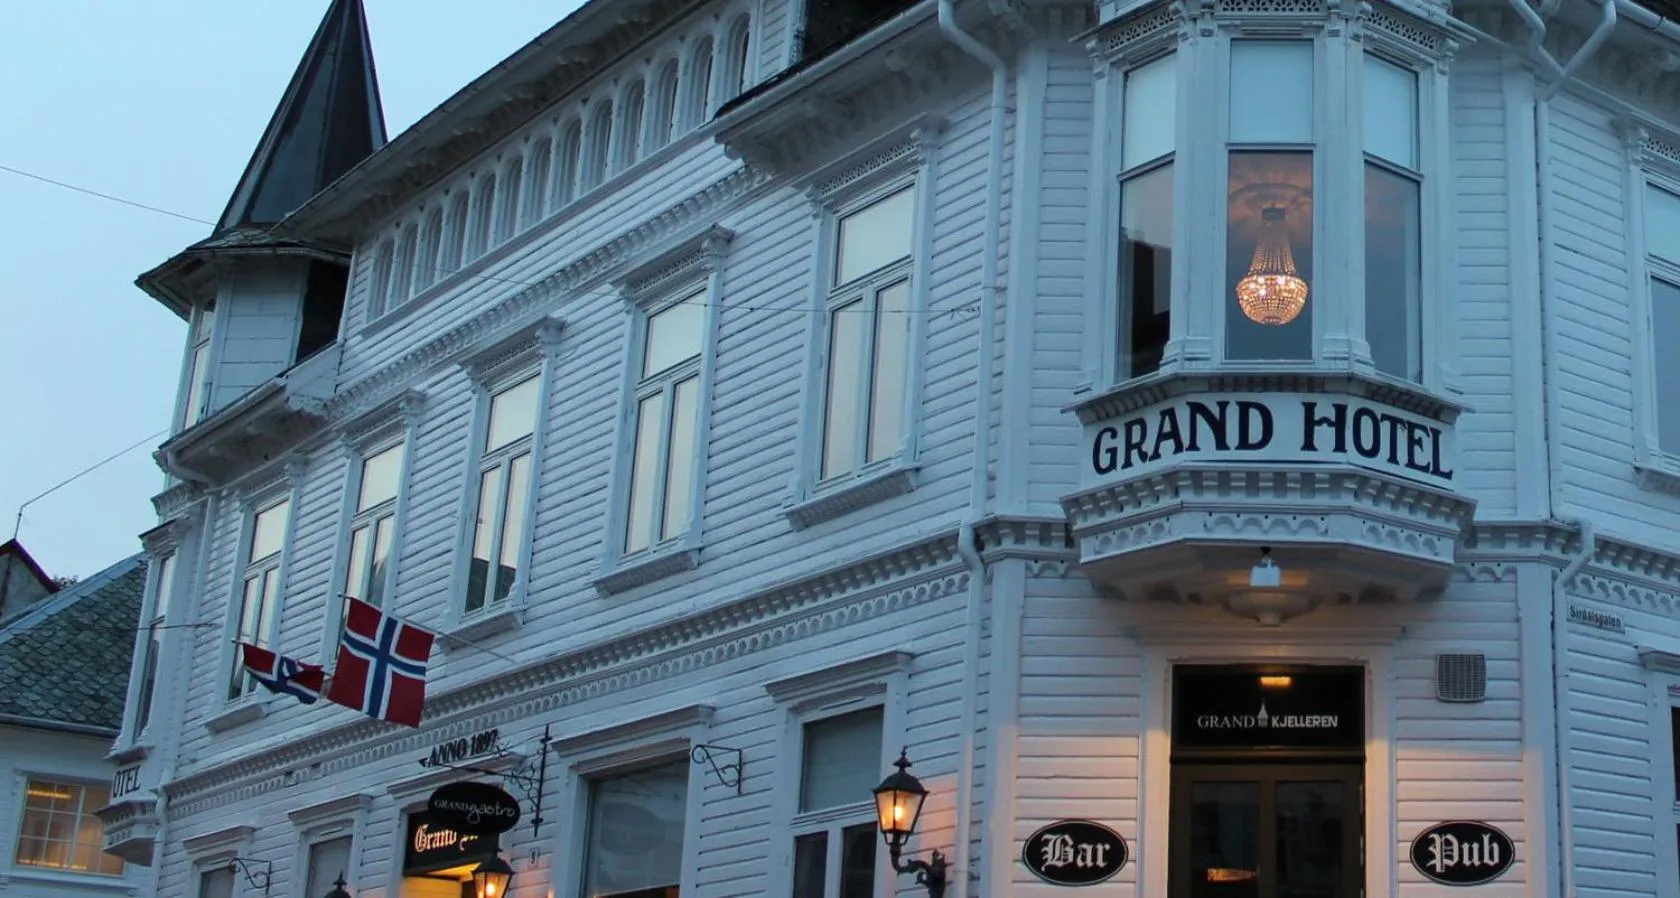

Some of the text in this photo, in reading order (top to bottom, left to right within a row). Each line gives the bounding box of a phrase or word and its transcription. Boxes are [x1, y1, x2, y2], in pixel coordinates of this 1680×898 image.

[1092, 400, 1453, 480] GRAND HOTEL
[1197, 715, 1338, 729] GRAND KJELLEREN
[428, 729, 498, 767] ANNO 1897
[1041, 834, 1111, 872] Bar
[1425, 833, 1500, 873] Pub
